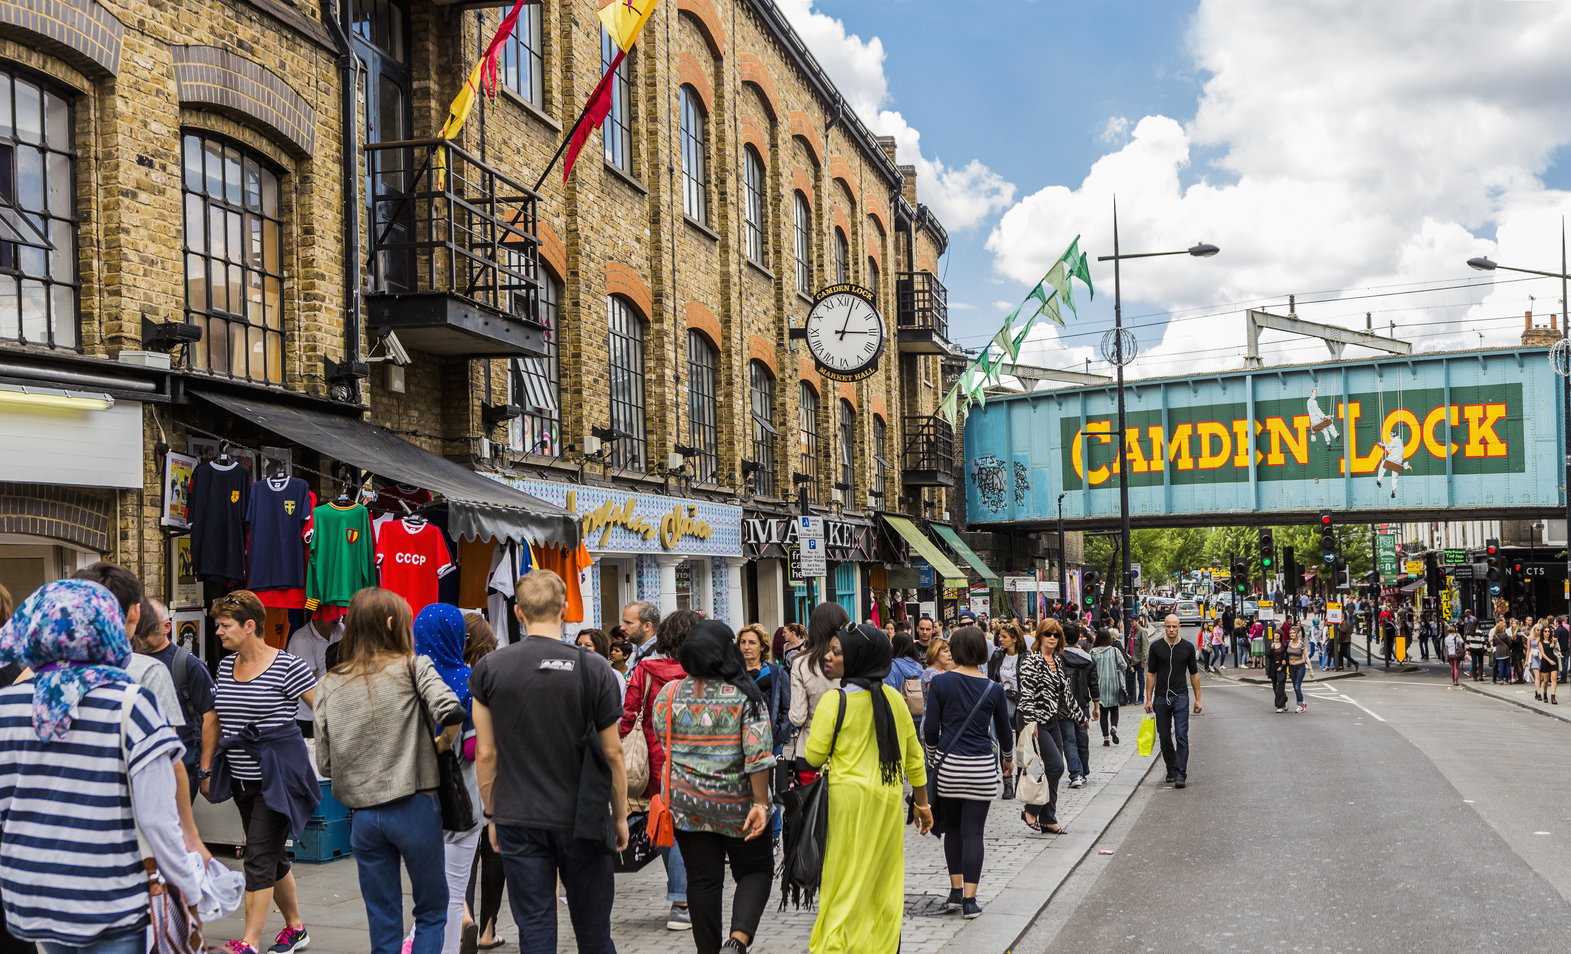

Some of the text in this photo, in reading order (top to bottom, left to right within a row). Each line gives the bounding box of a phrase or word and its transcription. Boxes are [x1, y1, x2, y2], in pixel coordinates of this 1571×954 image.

[816, 285, 874, 300] CAMDEN LOCK
[818, 366, 876, 381] MARKET HALL
[1072, 414, 1310, 485] CAMDEN
[1337, 401, 1508, 474] LOCK
[746, 518, 856, 548] MAKET
